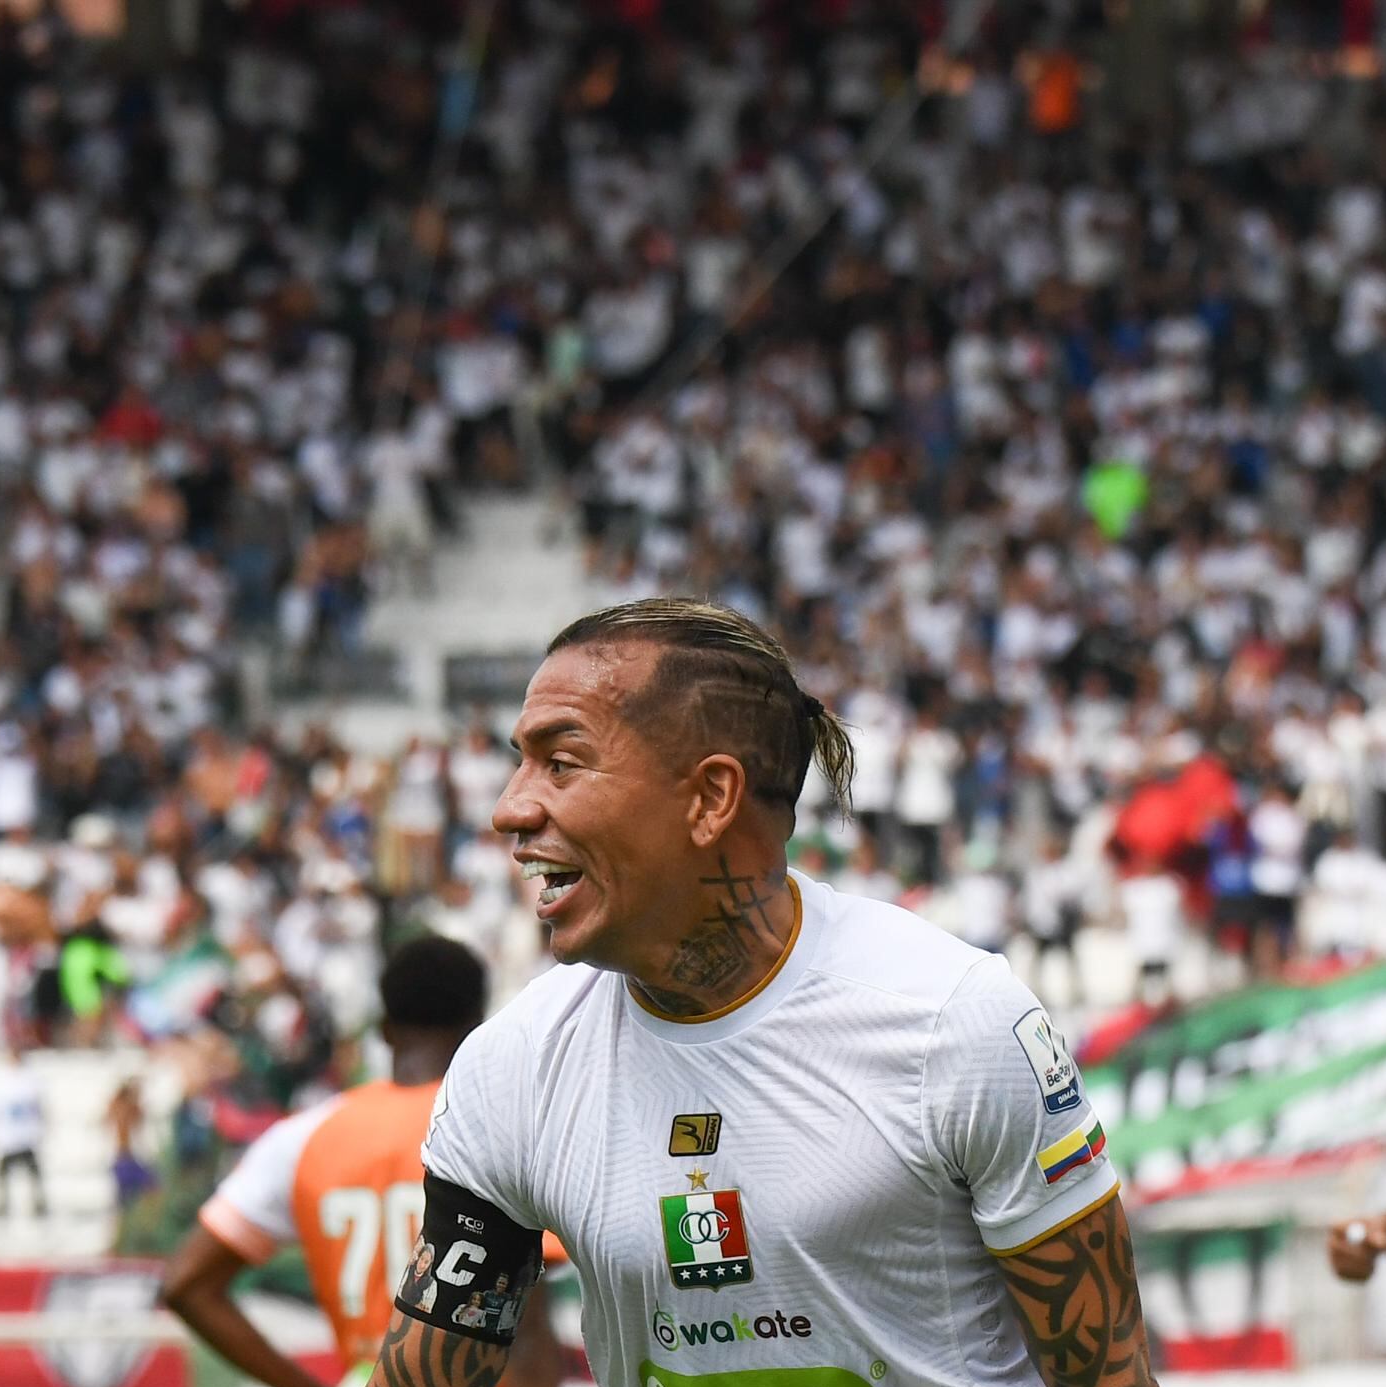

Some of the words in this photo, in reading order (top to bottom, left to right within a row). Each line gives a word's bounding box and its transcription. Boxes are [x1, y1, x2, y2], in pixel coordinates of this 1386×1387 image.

[1045, 1064, 1071, 1088] BePlay
[435, 1239, 488, 1288] C
[680, 1310, 811, 1346] wakate
